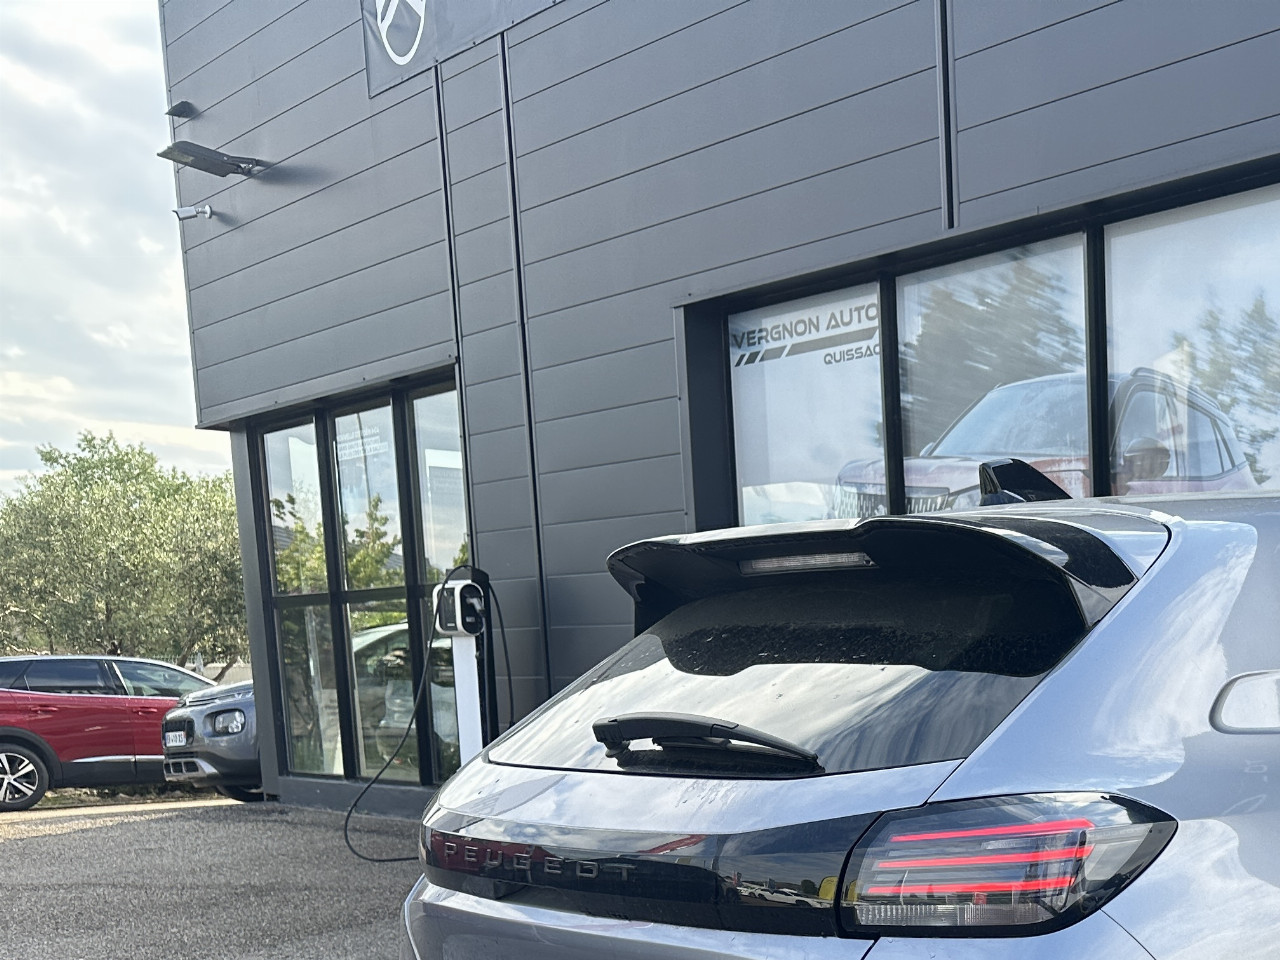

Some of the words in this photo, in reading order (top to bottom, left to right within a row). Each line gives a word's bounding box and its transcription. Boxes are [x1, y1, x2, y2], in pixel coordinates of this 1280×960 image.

[732, 315, 819, 349] VERGNON
[826, 302, 878, 331] AUTO
[444, 842, 638, 881] PEUGEOT
